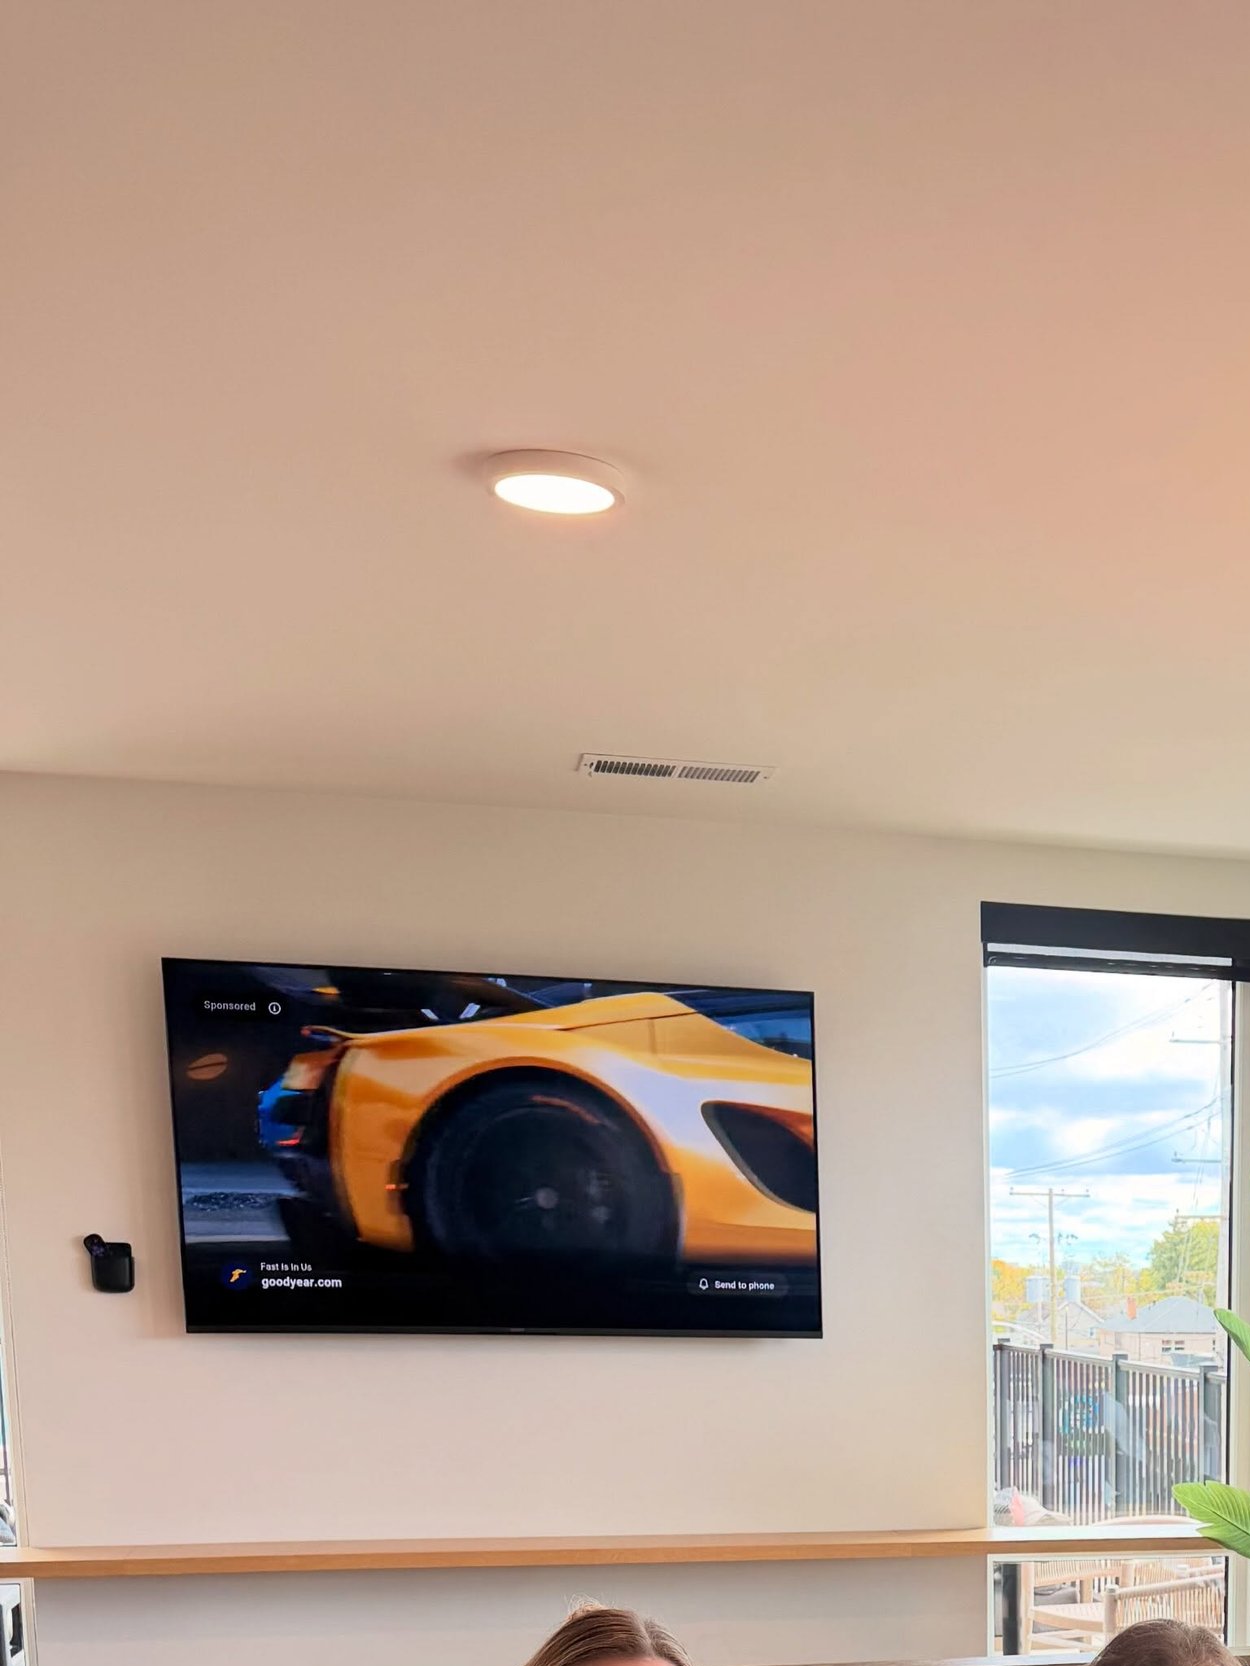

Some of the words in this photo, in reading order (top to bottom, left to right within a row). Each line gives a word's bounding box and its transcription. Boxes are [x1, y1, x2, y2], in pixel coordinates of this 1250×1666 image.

[204, 1000, 256, 1012] Sponsored
[260, 1262, 279, 1271] Fast
[281, 1263, 289, 1271] Is
[291, 1263, 299, 1272] In
[300, 1263, 313, 1272] Us
[261, 1276, 343, 1290] goodyear.com
[714, 1280, 736, 1290] Send
[738, 1281, 747, 1290] to
[748, 1281, 775, 1291] phone
